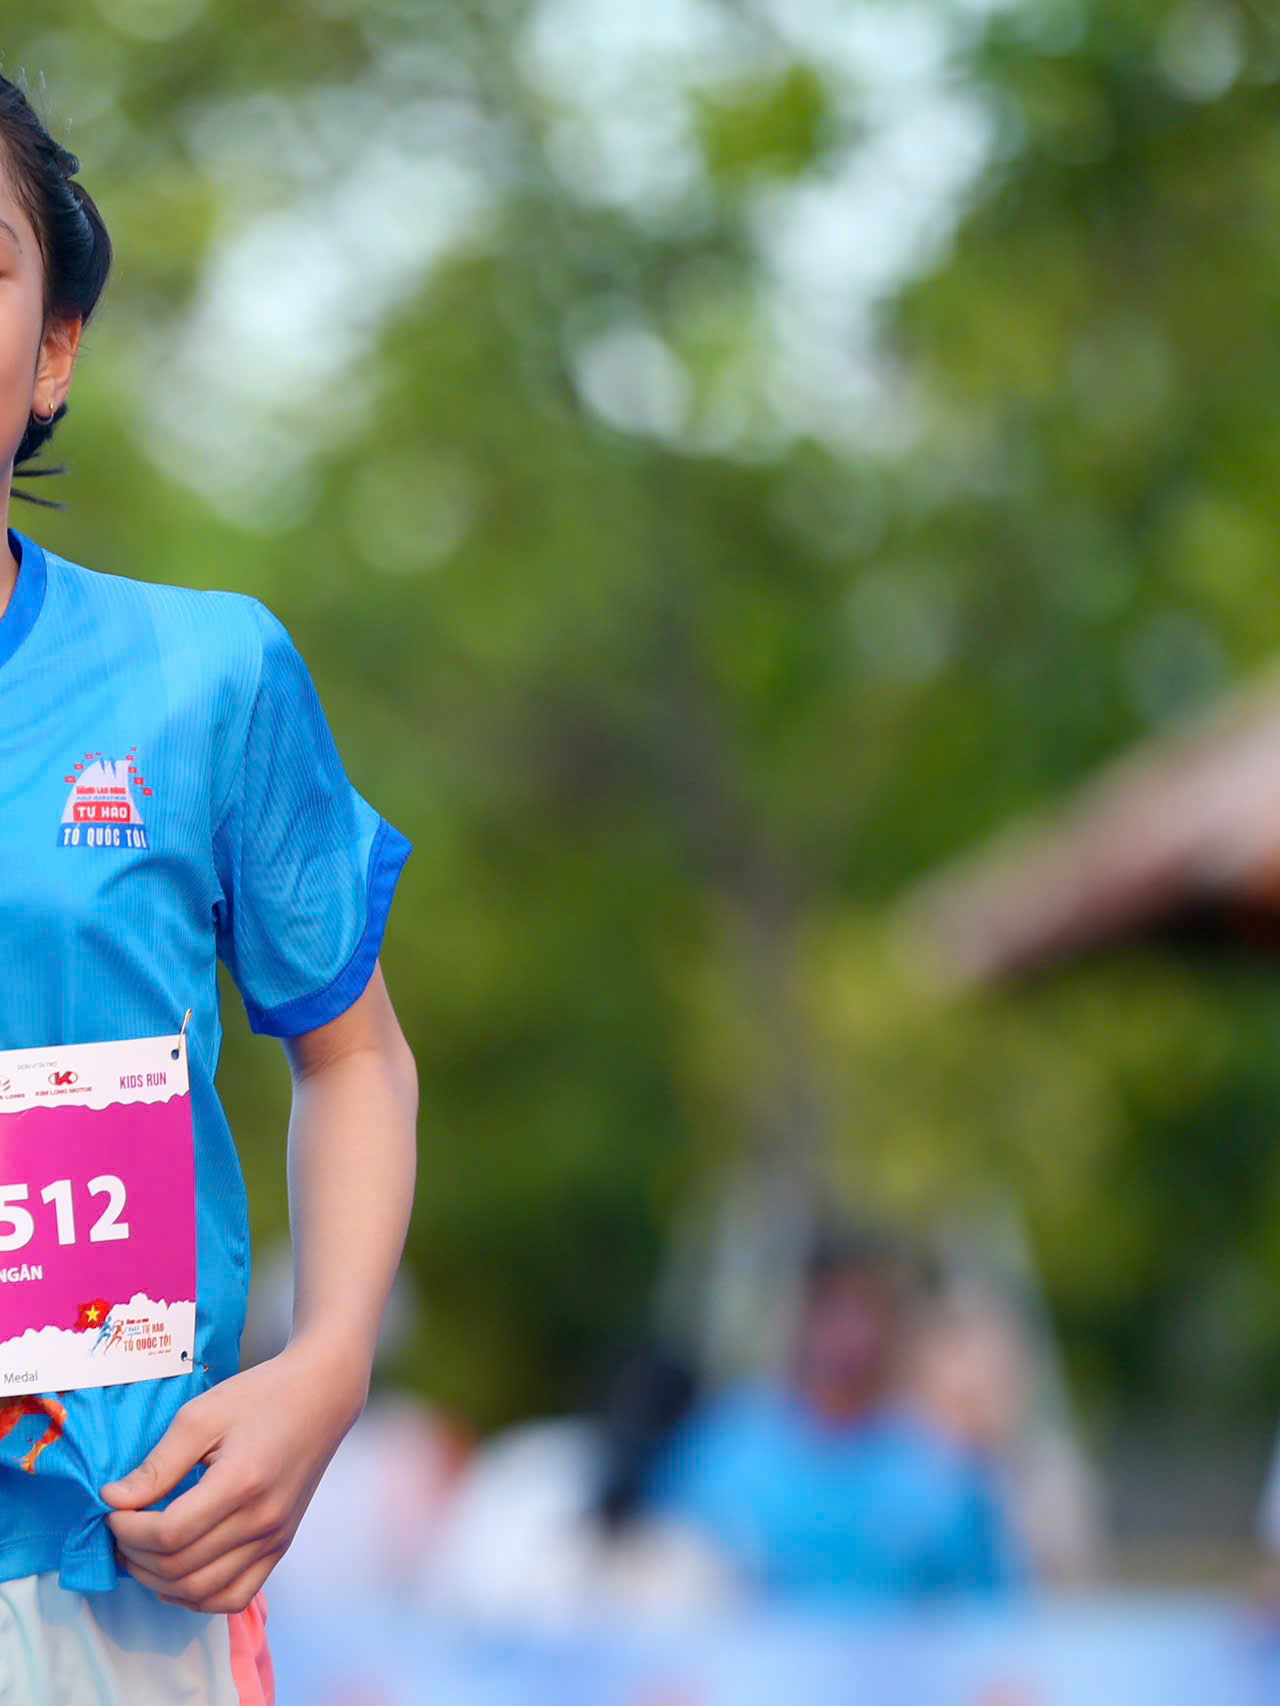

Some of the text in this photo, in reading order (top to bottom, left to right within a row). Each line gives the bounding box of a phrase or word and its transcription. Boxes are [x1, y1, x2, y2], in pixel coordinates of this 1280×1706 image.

[120, 1072, 167, 1089] KIDS RUN
[3, 1370, 39, 1384] Medal
